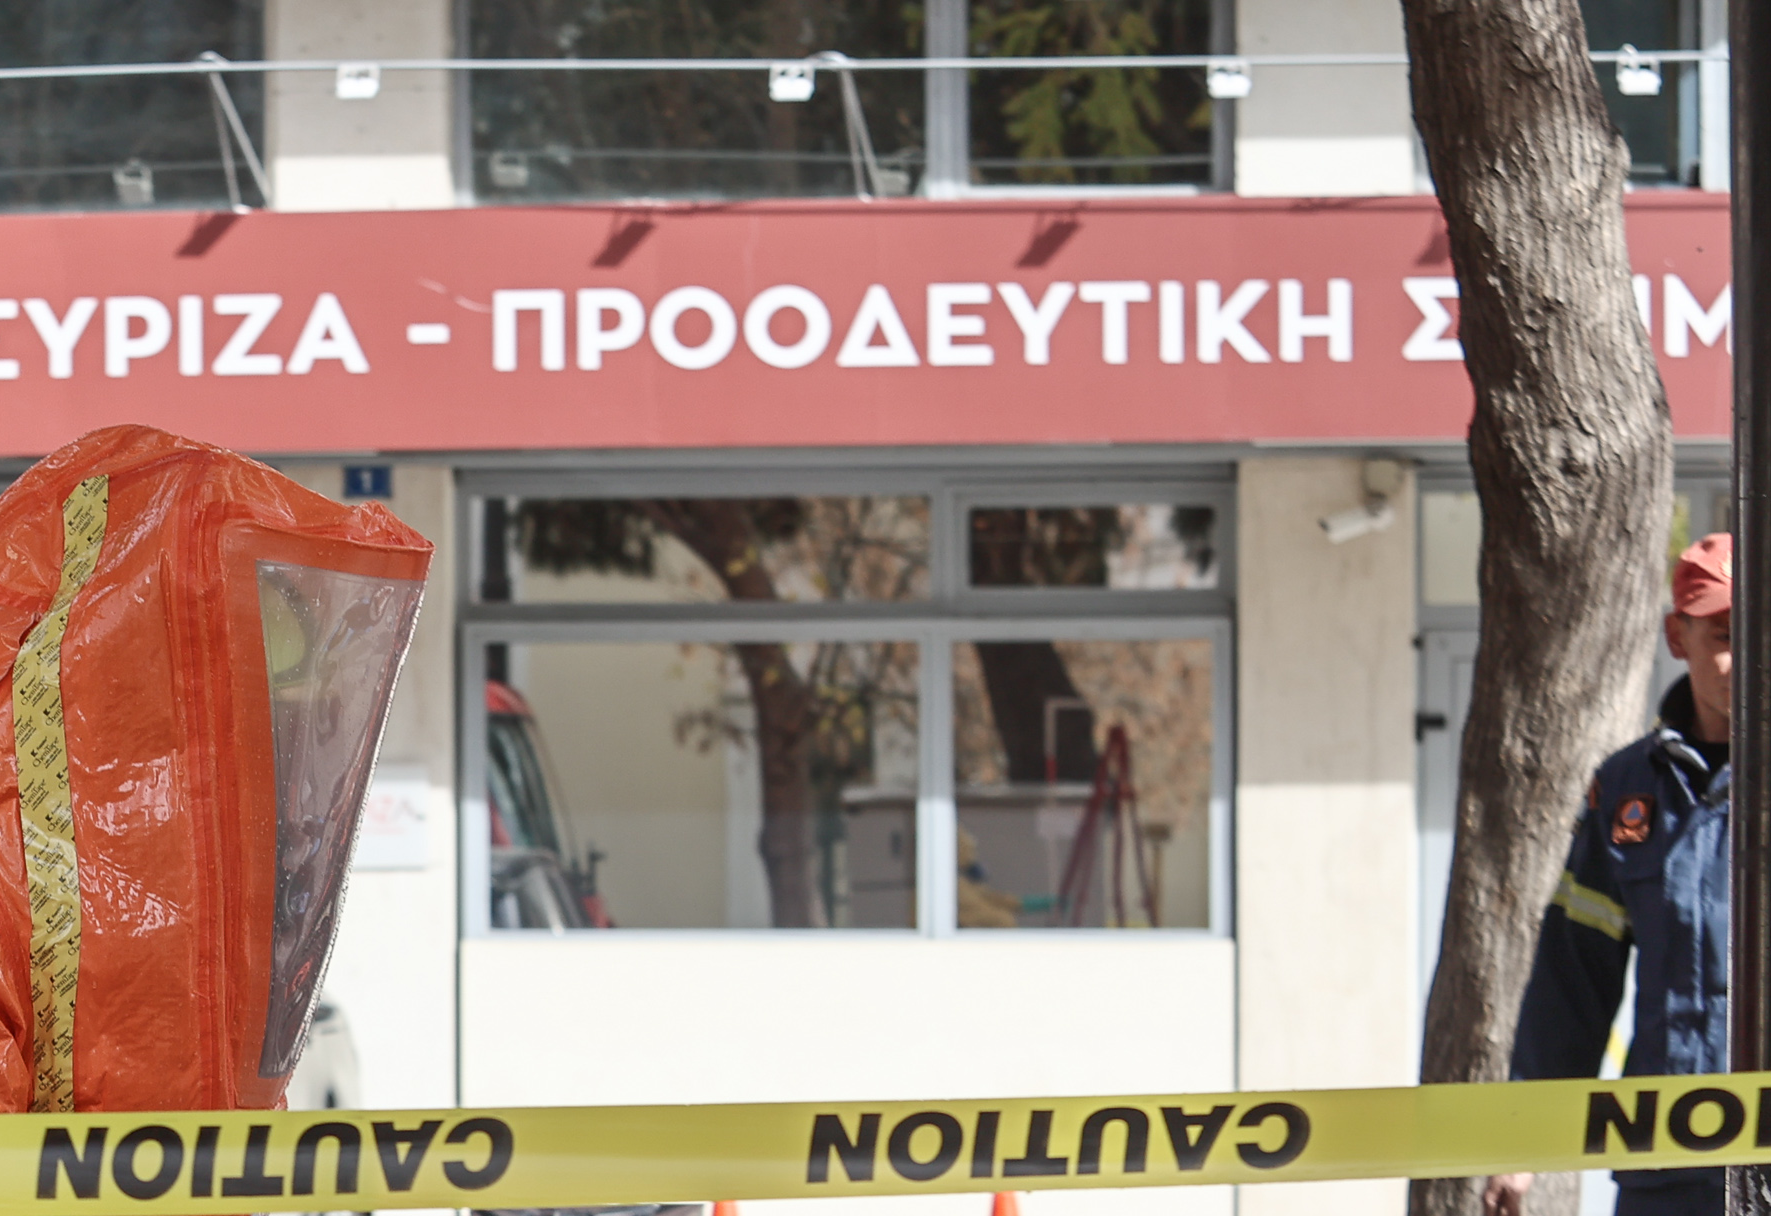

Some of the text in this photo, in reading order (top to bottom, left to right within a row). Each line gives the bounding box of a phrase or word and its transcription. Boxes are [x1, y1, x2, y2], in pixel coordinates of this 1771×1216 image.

[406, 323, 451, 345] -
[492, 279, 1354, 371] ΠΡΟΟΔΕΥΤΙΚΗ
[36, 1117, 515, 1200] CAUTION
[806, 1102, 1311, 1183] CAUTION
